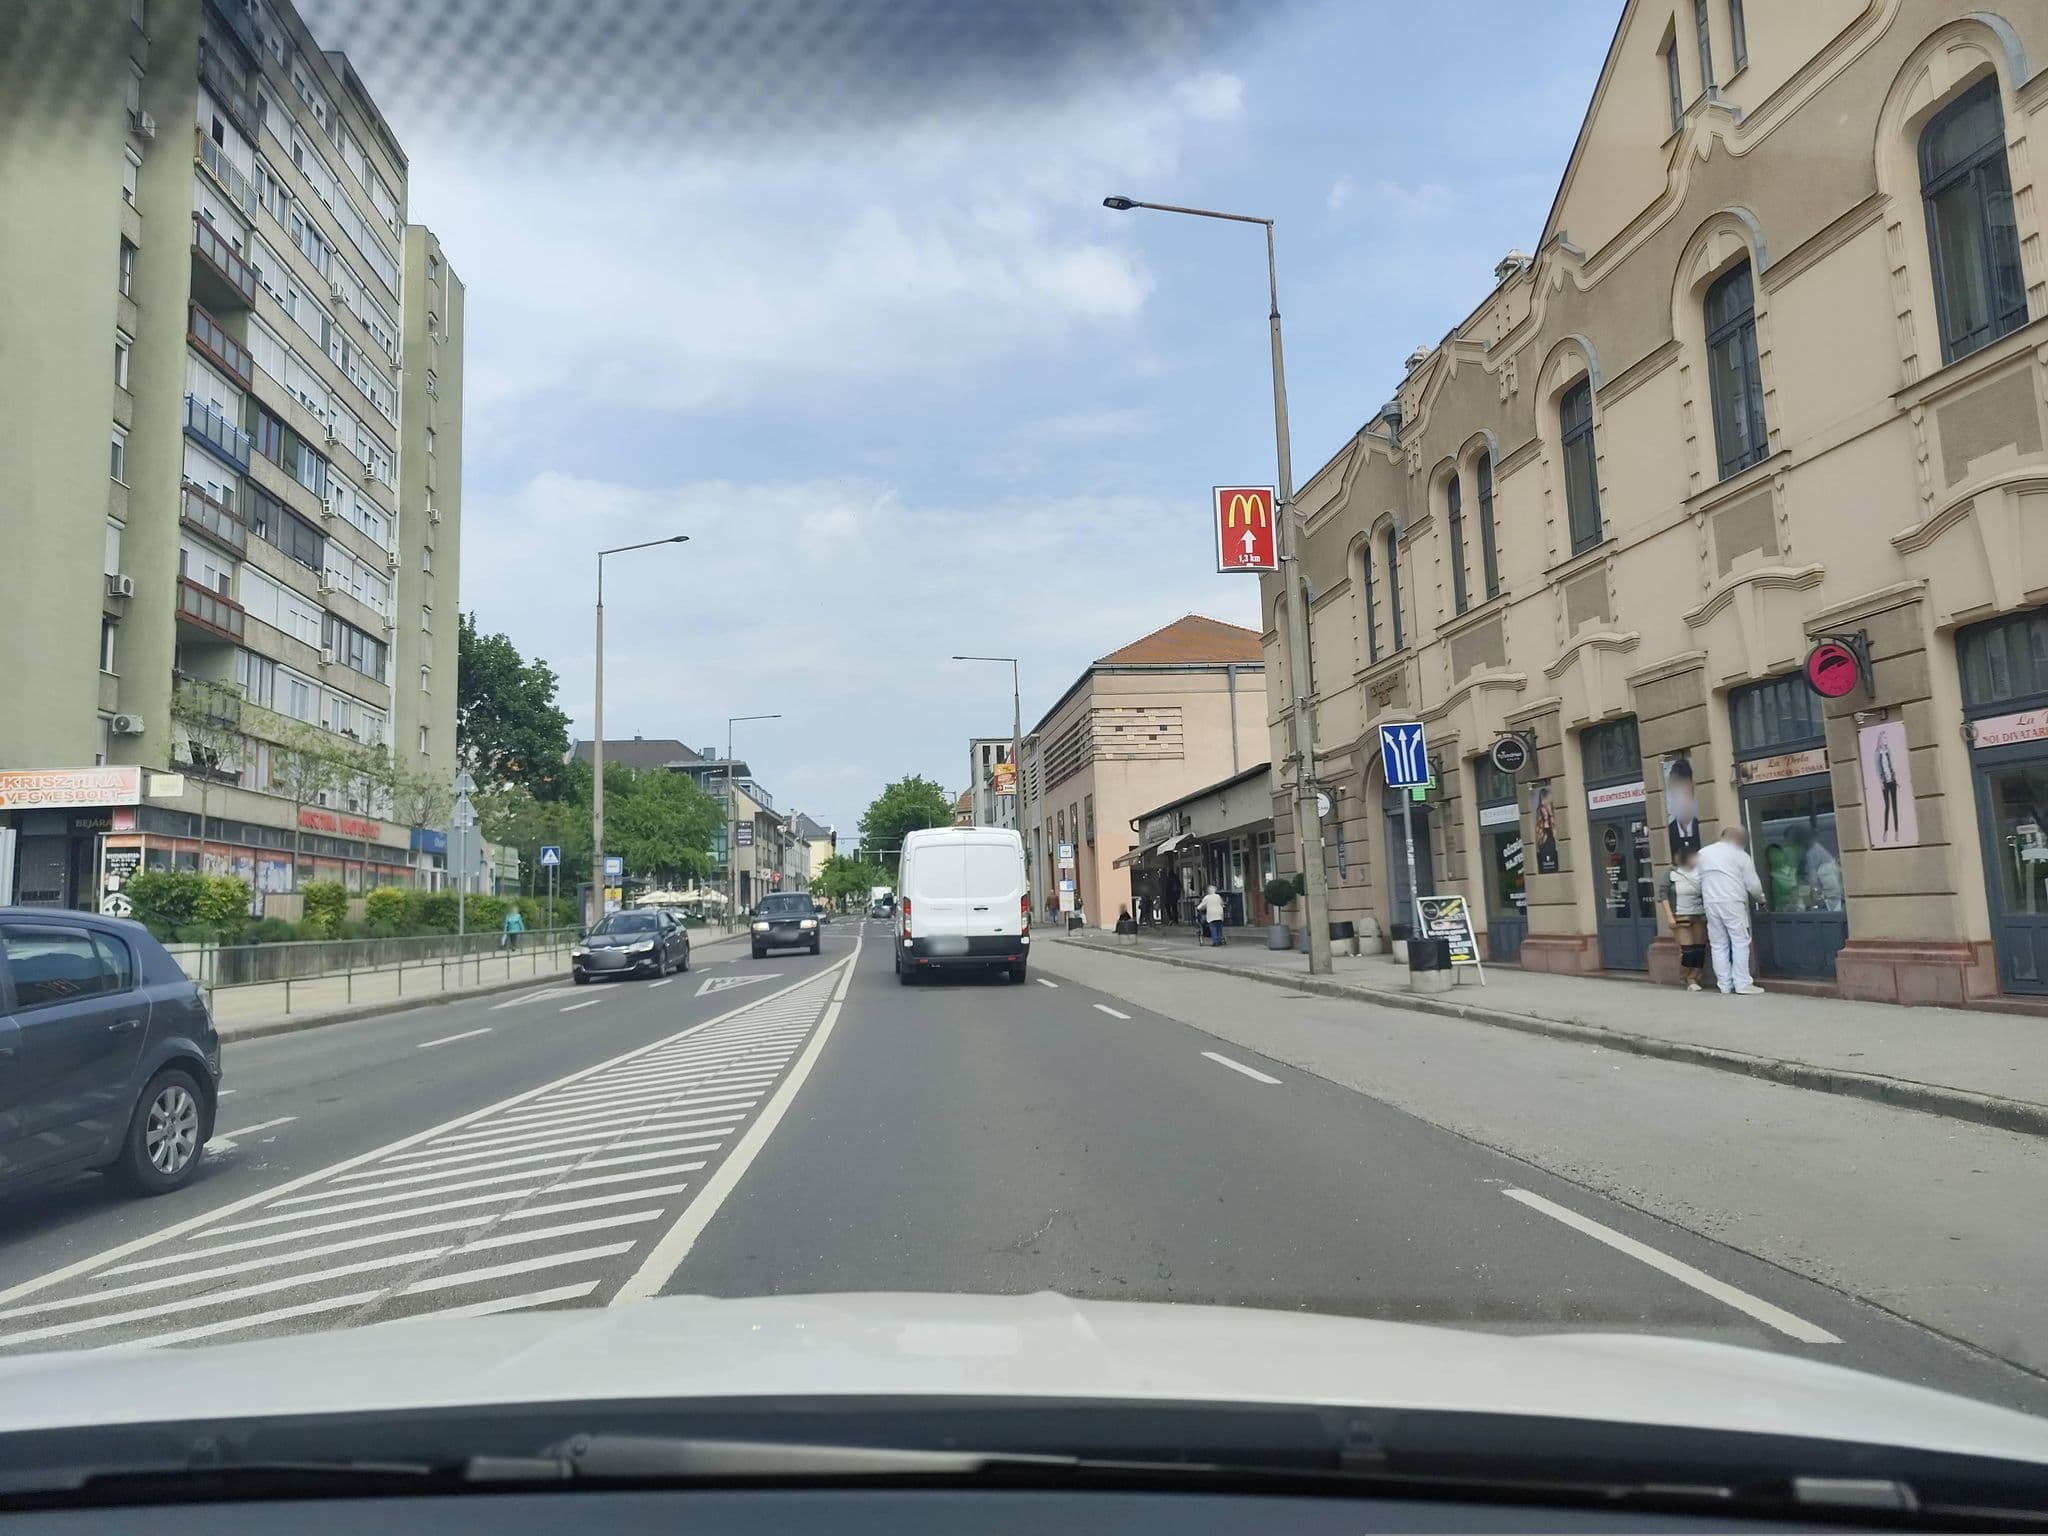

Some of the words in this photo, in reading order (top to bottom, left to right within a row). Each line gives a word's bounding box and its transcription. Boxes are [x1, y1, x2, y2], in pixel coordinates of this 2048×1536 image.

[1228, 494, 1267, 528] M
[4, 774, 126, 790] KRISZTINA
[6, 790, 120, 804] VEGYESBOLT
[75, 818, 113, 829] BEJÁRA
